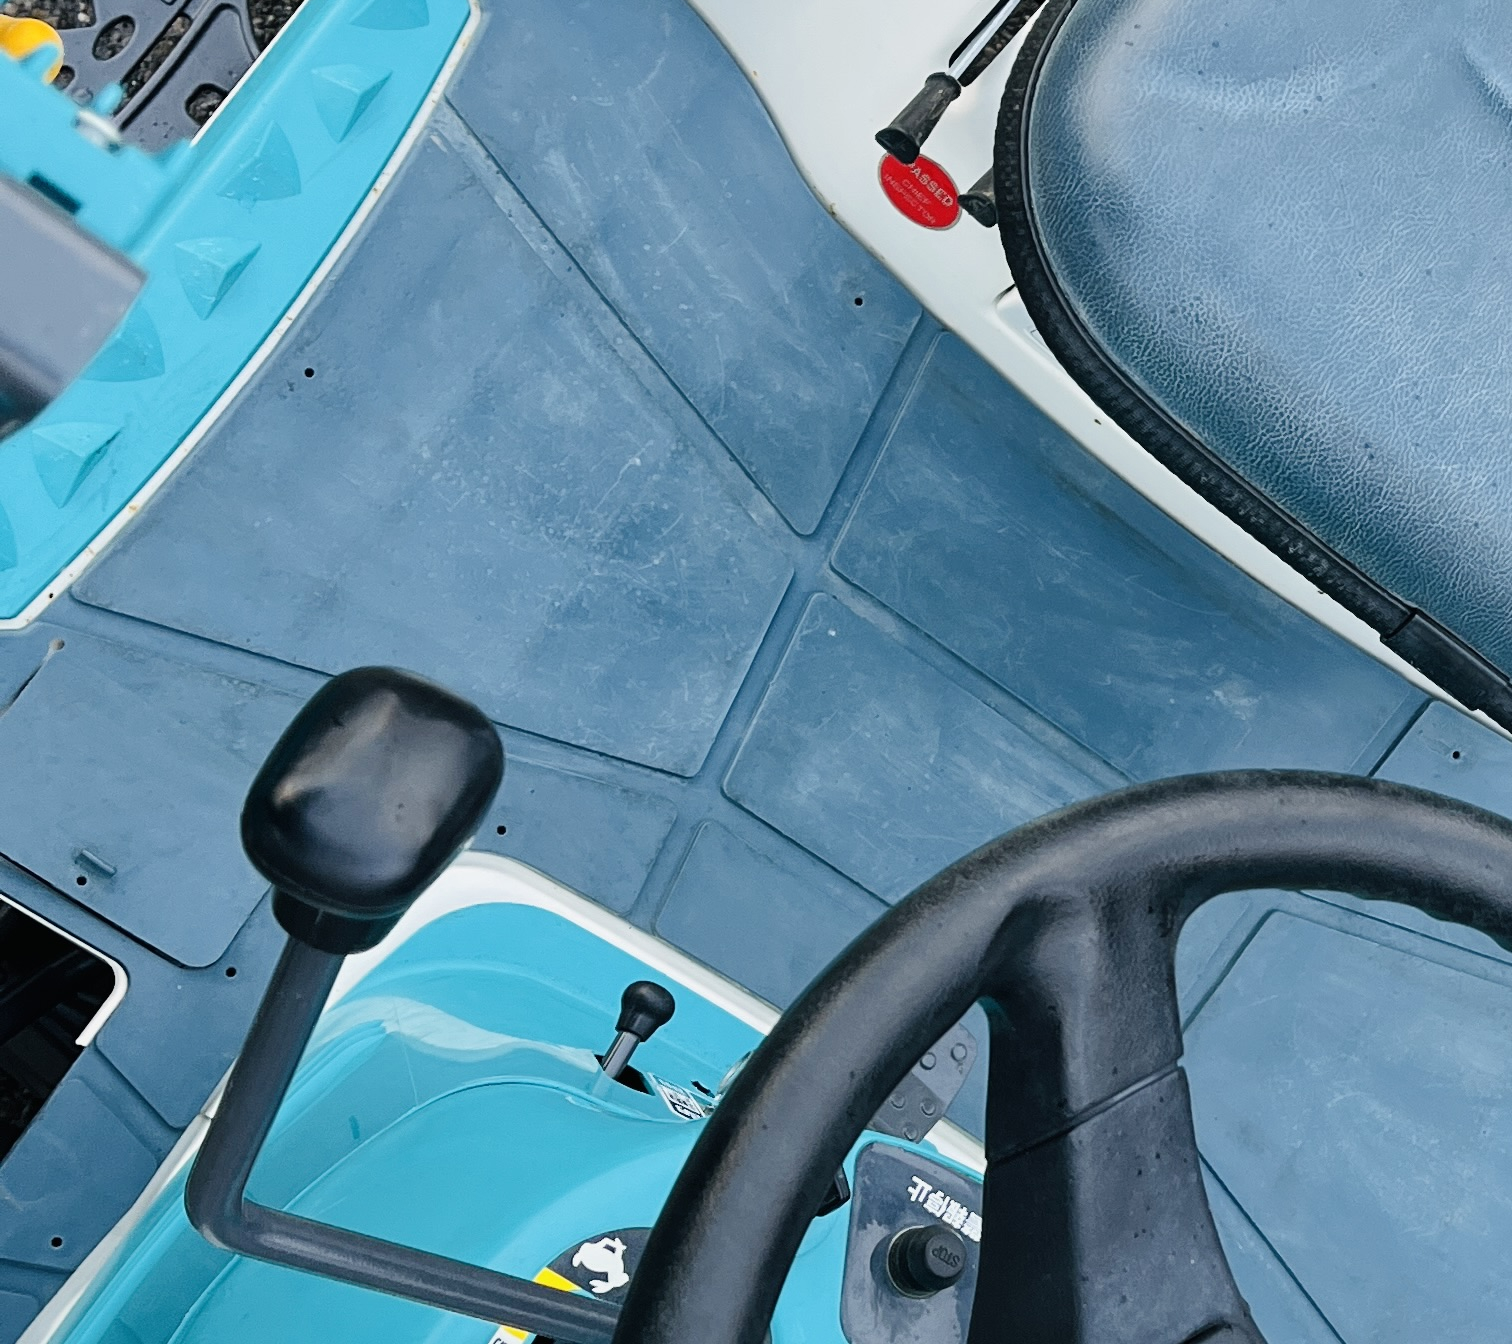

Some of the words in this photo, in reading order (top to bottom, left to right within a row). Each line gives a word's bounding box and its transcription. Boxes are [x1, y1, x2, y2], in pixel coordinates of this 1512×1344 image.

[907, 1175, 983, 1242] 警報停止
[931, 1244, 961, 1268] STOP
